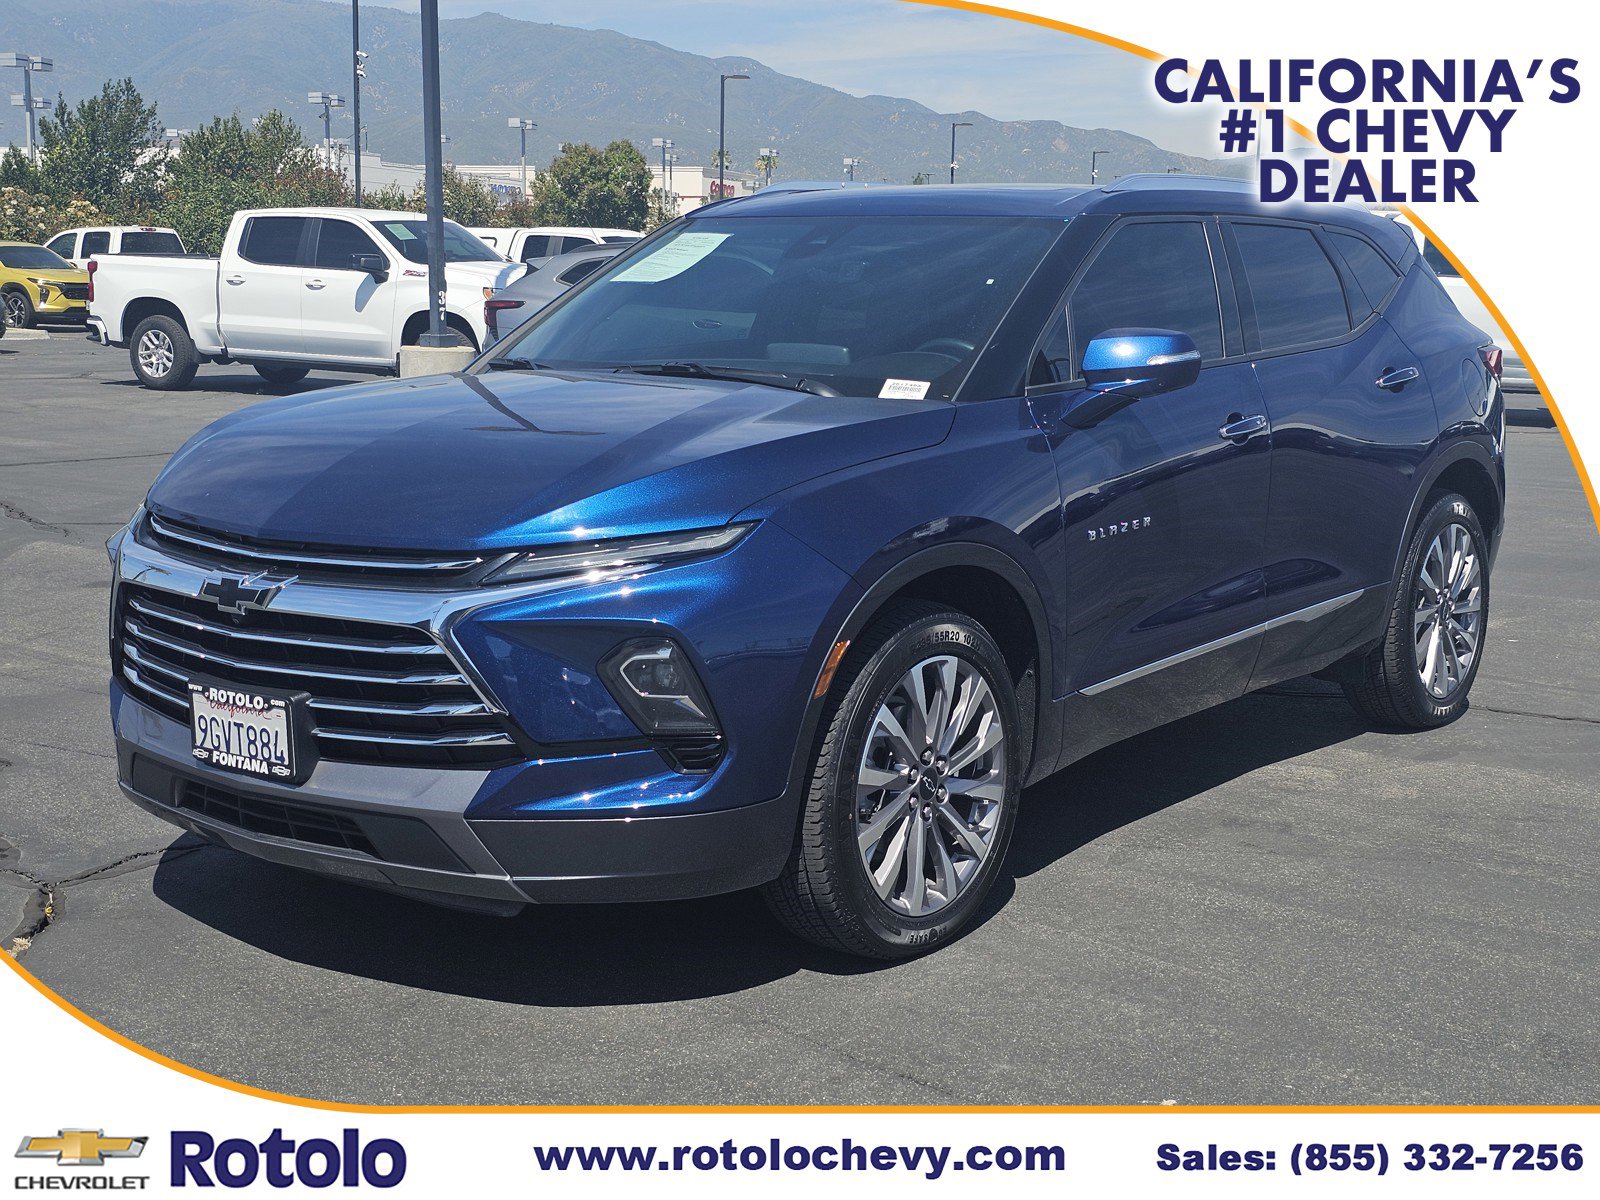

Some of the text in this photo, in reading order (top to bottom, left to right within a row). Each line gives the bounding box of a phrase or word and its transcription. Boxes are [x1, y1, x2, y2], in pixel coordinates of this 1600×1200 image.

[1087, 516, 1151, 541] BLAZER
[209, 687, 264, 710] ROTOLO
[197, 713, 287, 765] 9GVT884
[212, 750, 269, 775] FONTANA
